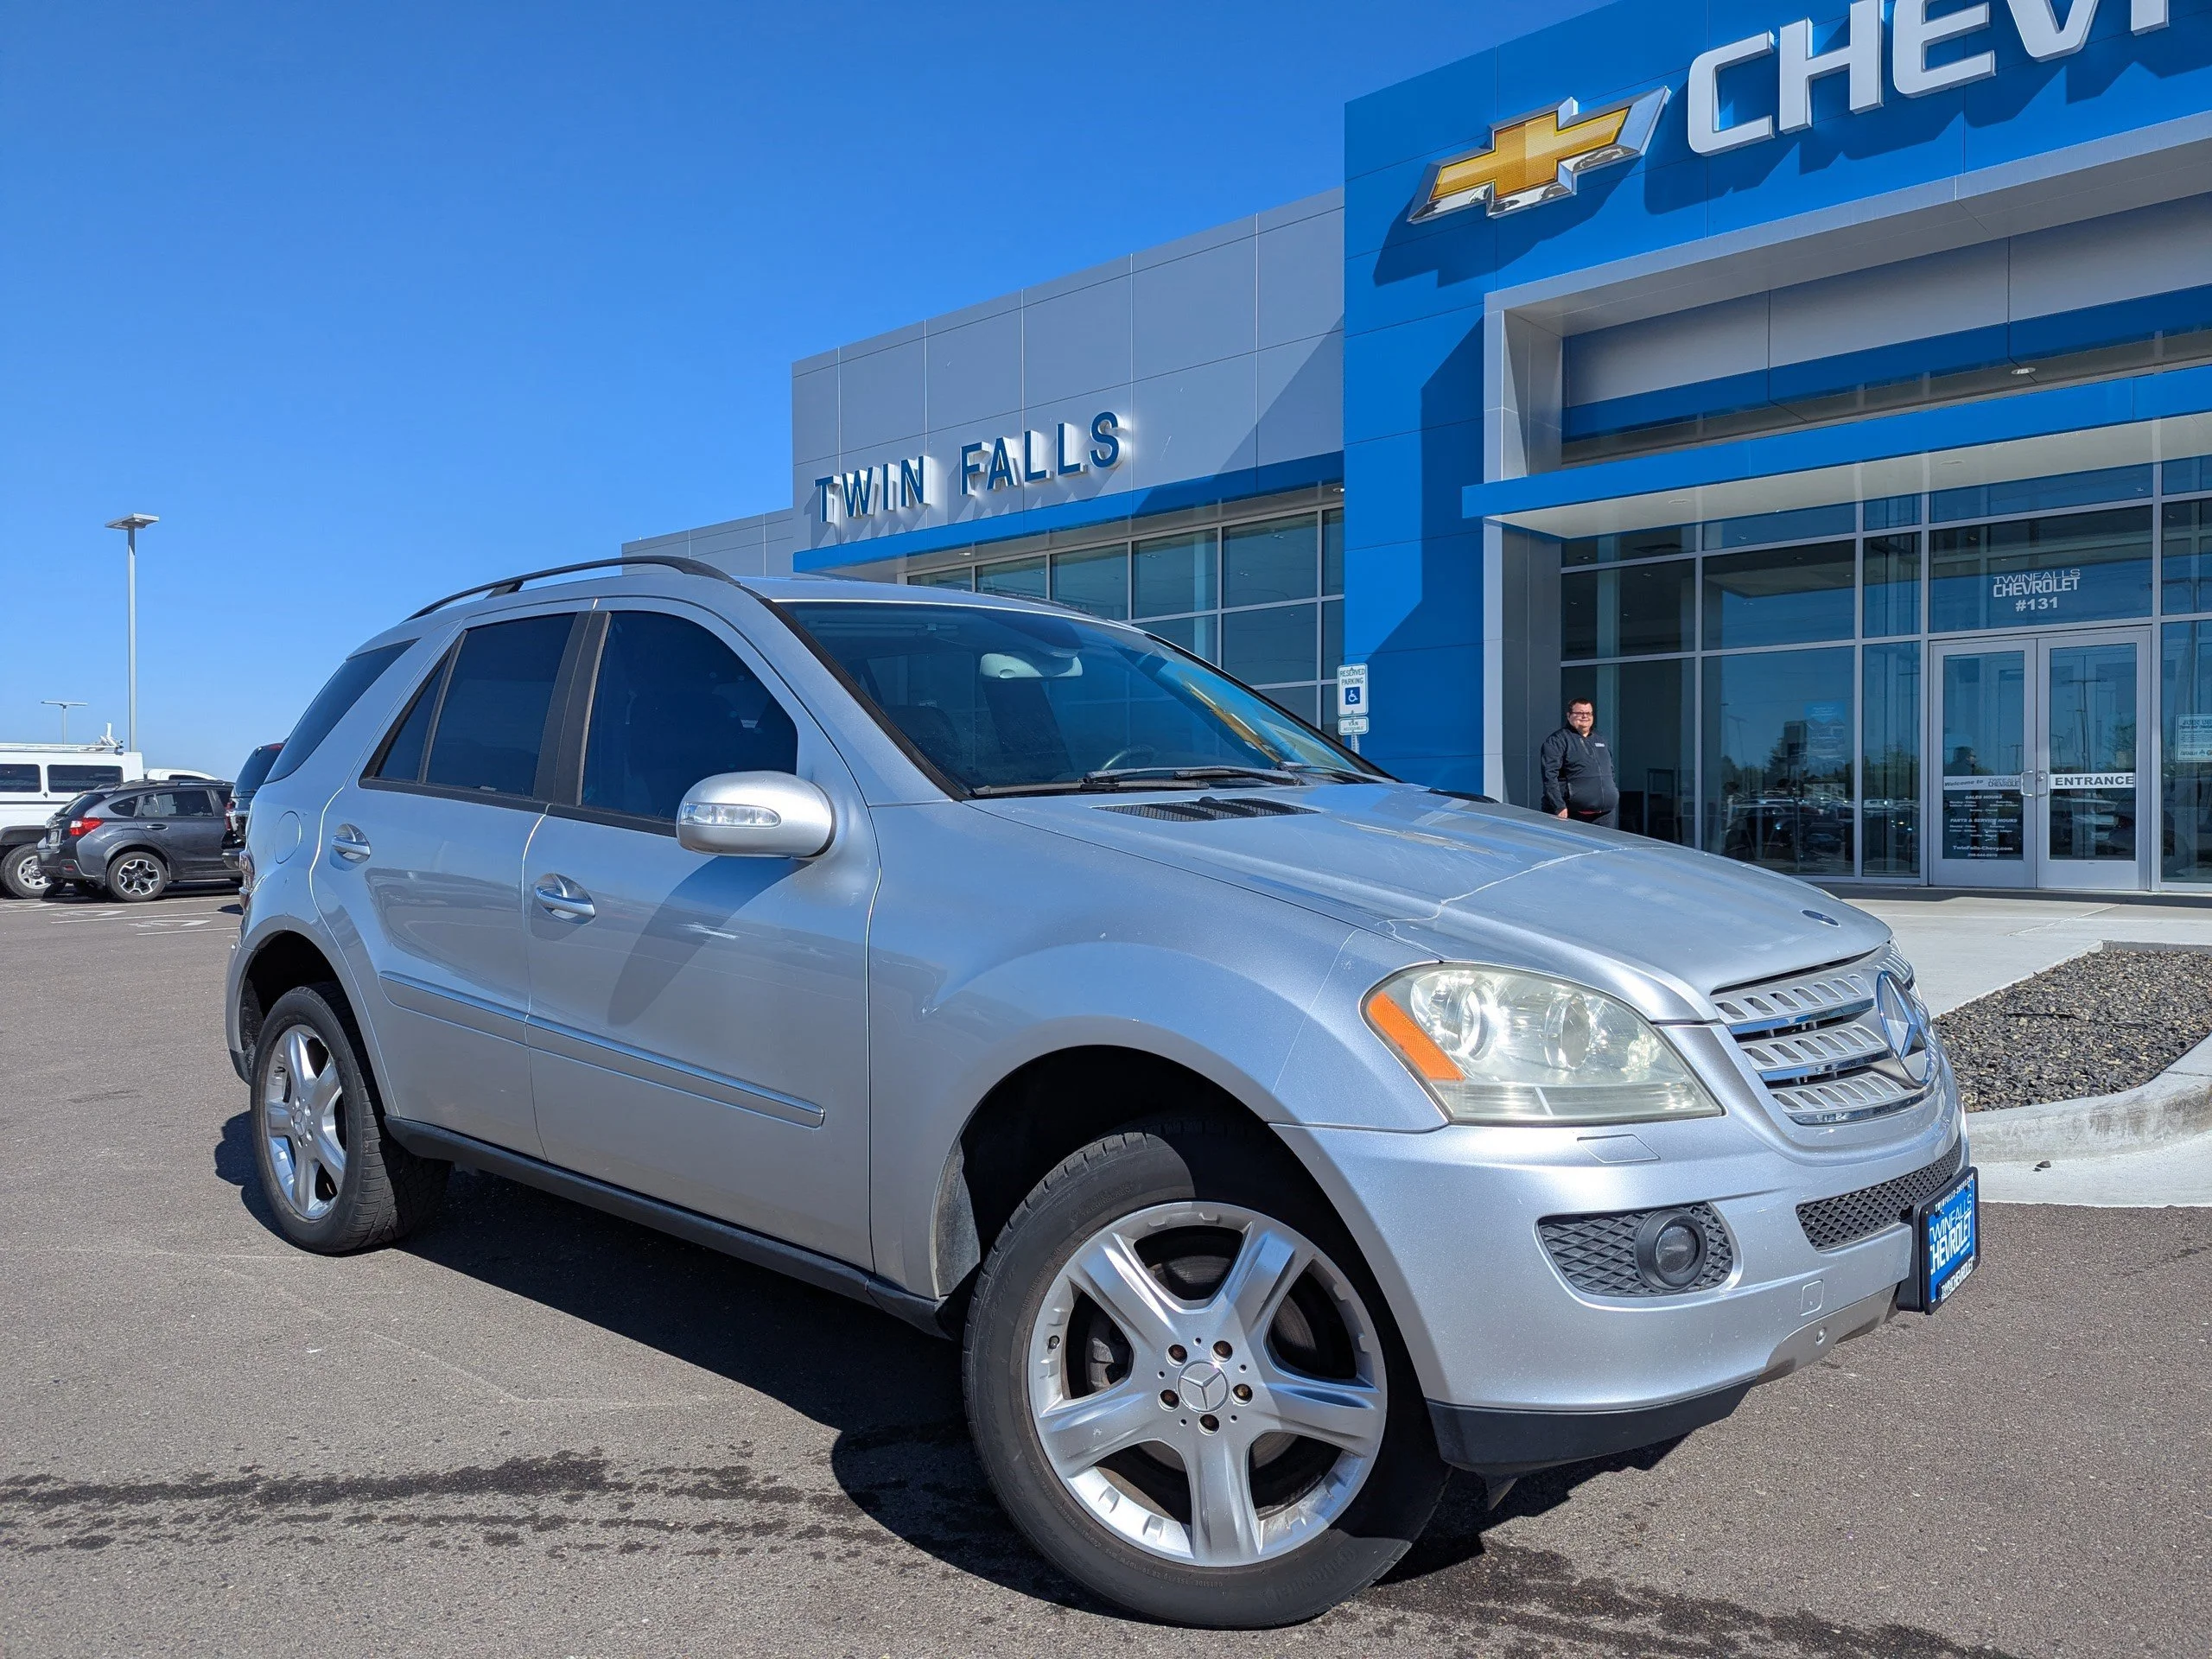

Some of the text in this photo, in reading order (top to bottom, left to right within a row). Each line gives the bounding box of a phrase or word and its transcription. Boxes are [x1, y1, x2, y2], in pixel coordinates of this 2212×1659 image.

[1688, 0, 2170, 156] CHEV
[814, 411, 1124, 524] TWIN FALLS
[1993, 569, 2081, 584] TWINFALLS
[1993, 576, 2081, 598] CHEVROLET
[2015, 597, 2058, 612] #131
[1339, 668, 1365, 677] RESERVED
[2055, 776, 2134, 785] ENTRANCE
